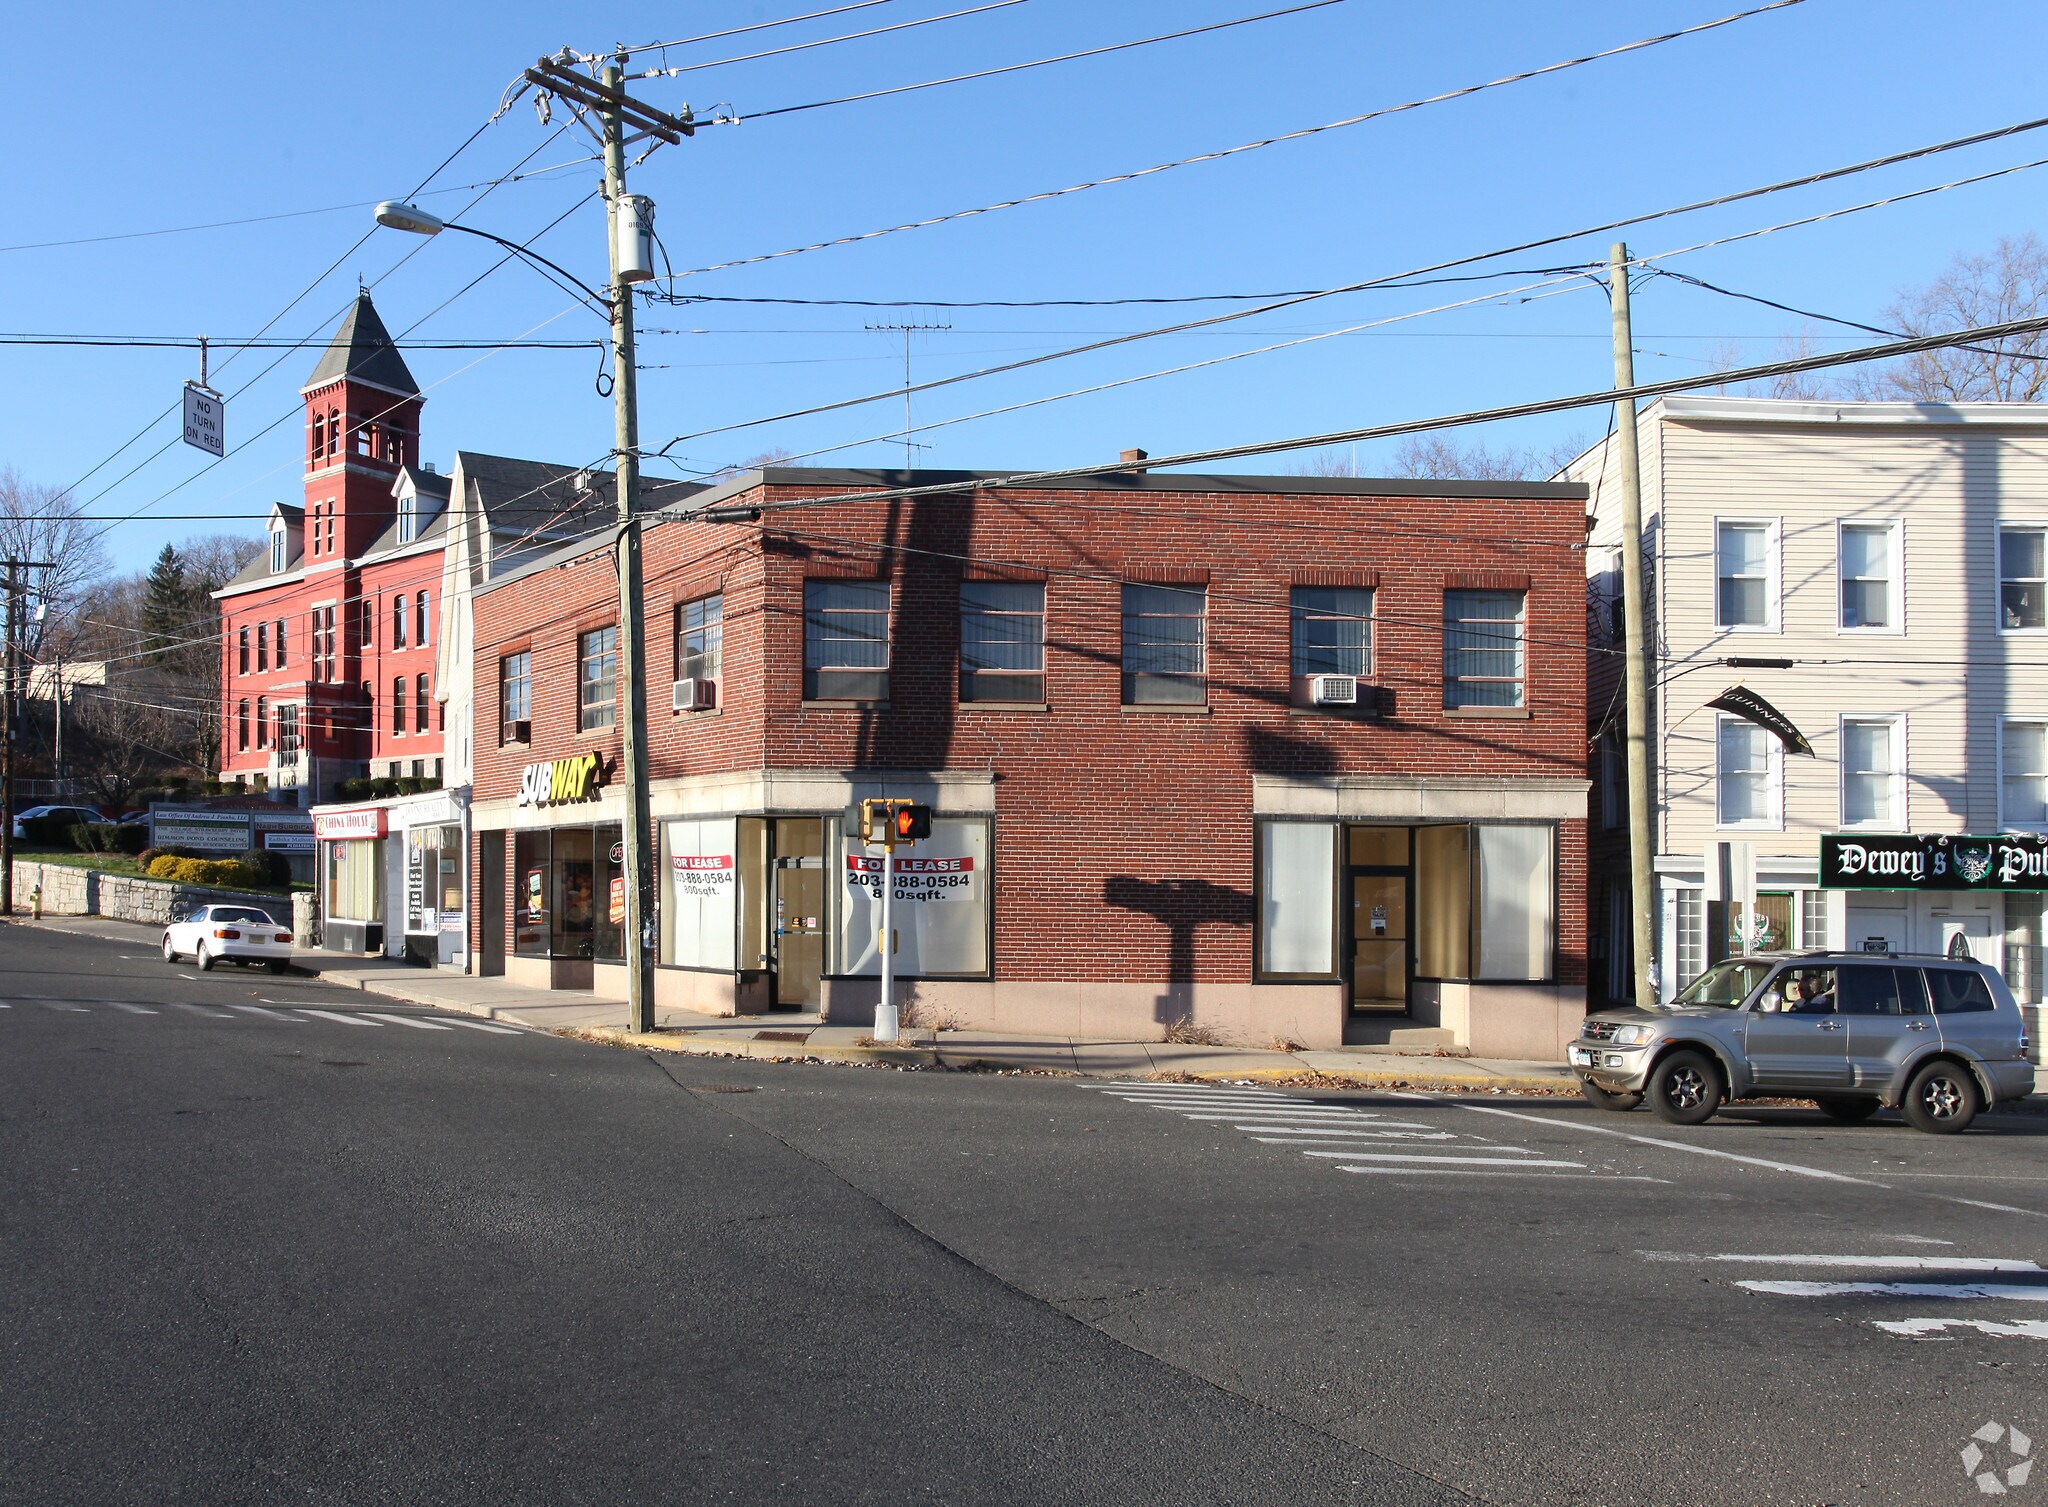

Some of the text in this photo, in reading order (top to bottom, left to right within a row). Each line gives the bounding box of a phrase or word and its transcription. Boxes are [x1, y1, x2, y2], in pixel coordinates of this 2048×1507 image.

[197, 400, 211, 413] NO
[193, 413, 215, 431] TURN
[186, 426, 221, 449] ON RED
[516, 750, 597, 805] SUBWAY
[325, 816, 345, 829] CHINA
[346, 814, 368, 828] HOUSE
[612, 846, 623, 858] OPE
[673, 857, 722, 869] FOR LEASE
[857, 859, 961, 872] FO LEASE
[1837, 843, 1947, 881] Dewey's
[872, 888, 946, 902] 80sqft.
